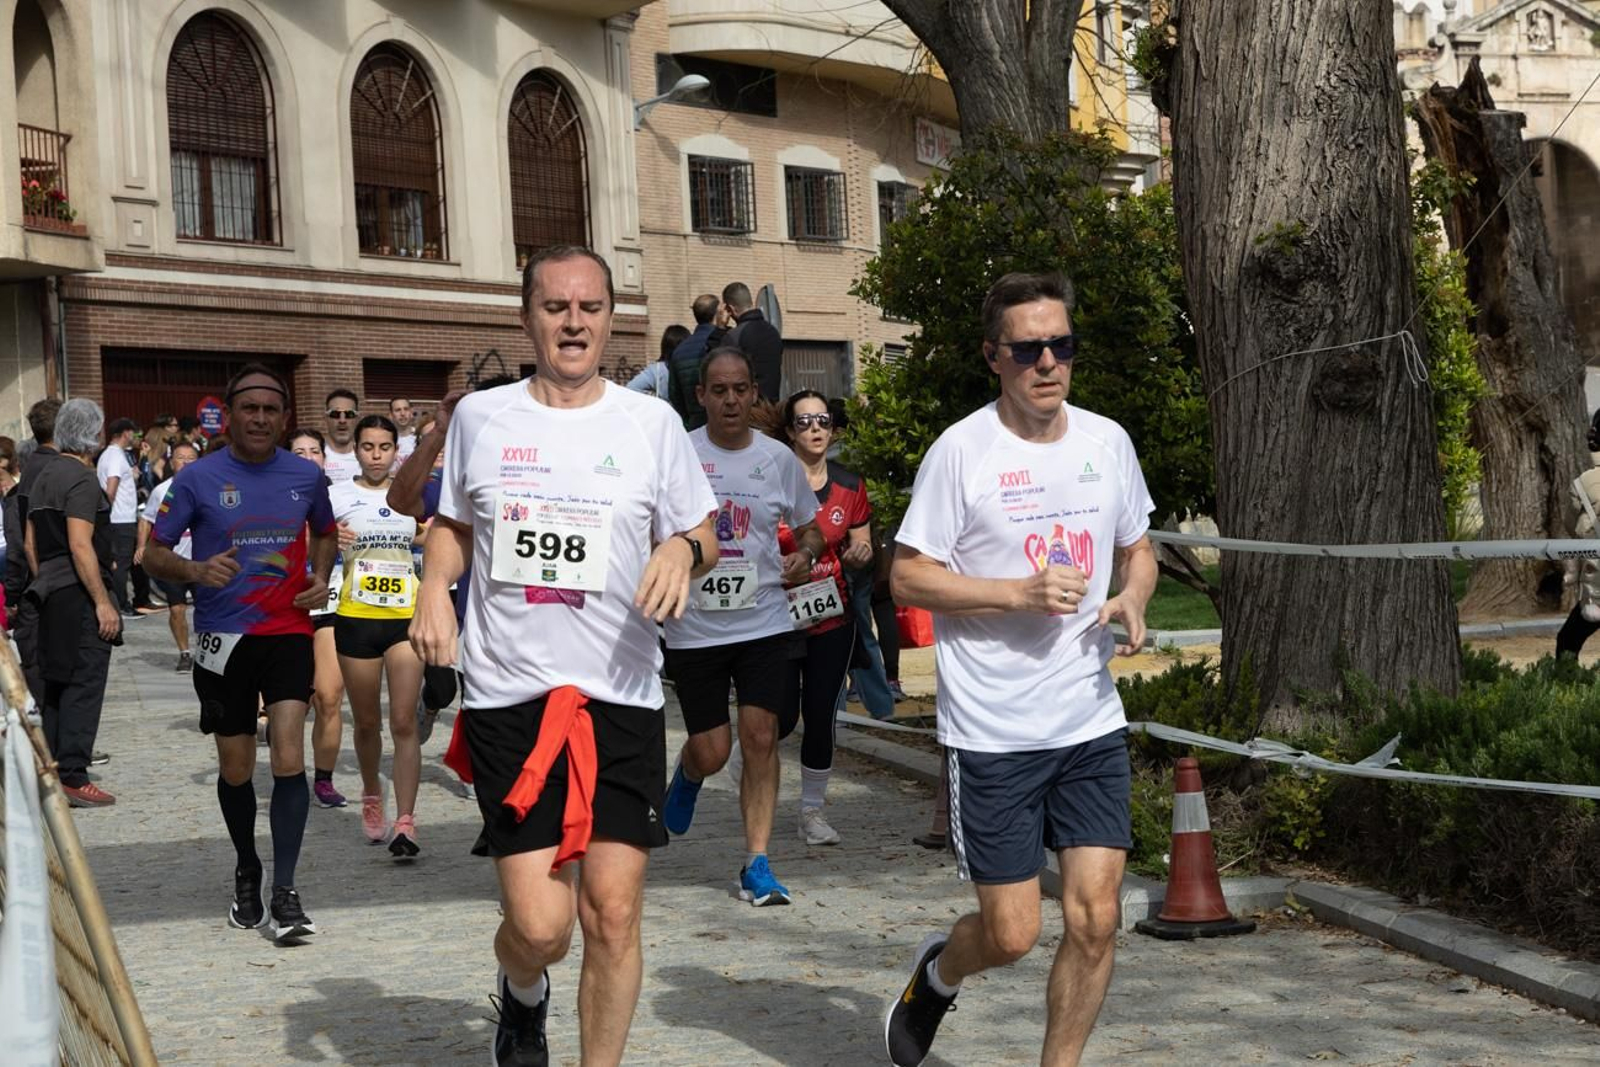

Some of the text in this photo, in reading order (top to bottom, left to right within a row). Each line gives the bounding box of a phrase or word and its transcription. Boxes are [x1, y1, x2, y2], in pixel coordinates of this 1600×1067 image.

[501, 447, 539, 463] XXVII
[998, 470, 1032, 488] XXVII
[232, 536, 275, 547] MARCHA
[515, 529, 586, 563] 598
[365, 576, 402, 593] 385
[701, 576, 745, 595] 467
[789, 594, 837, 620] 1164
